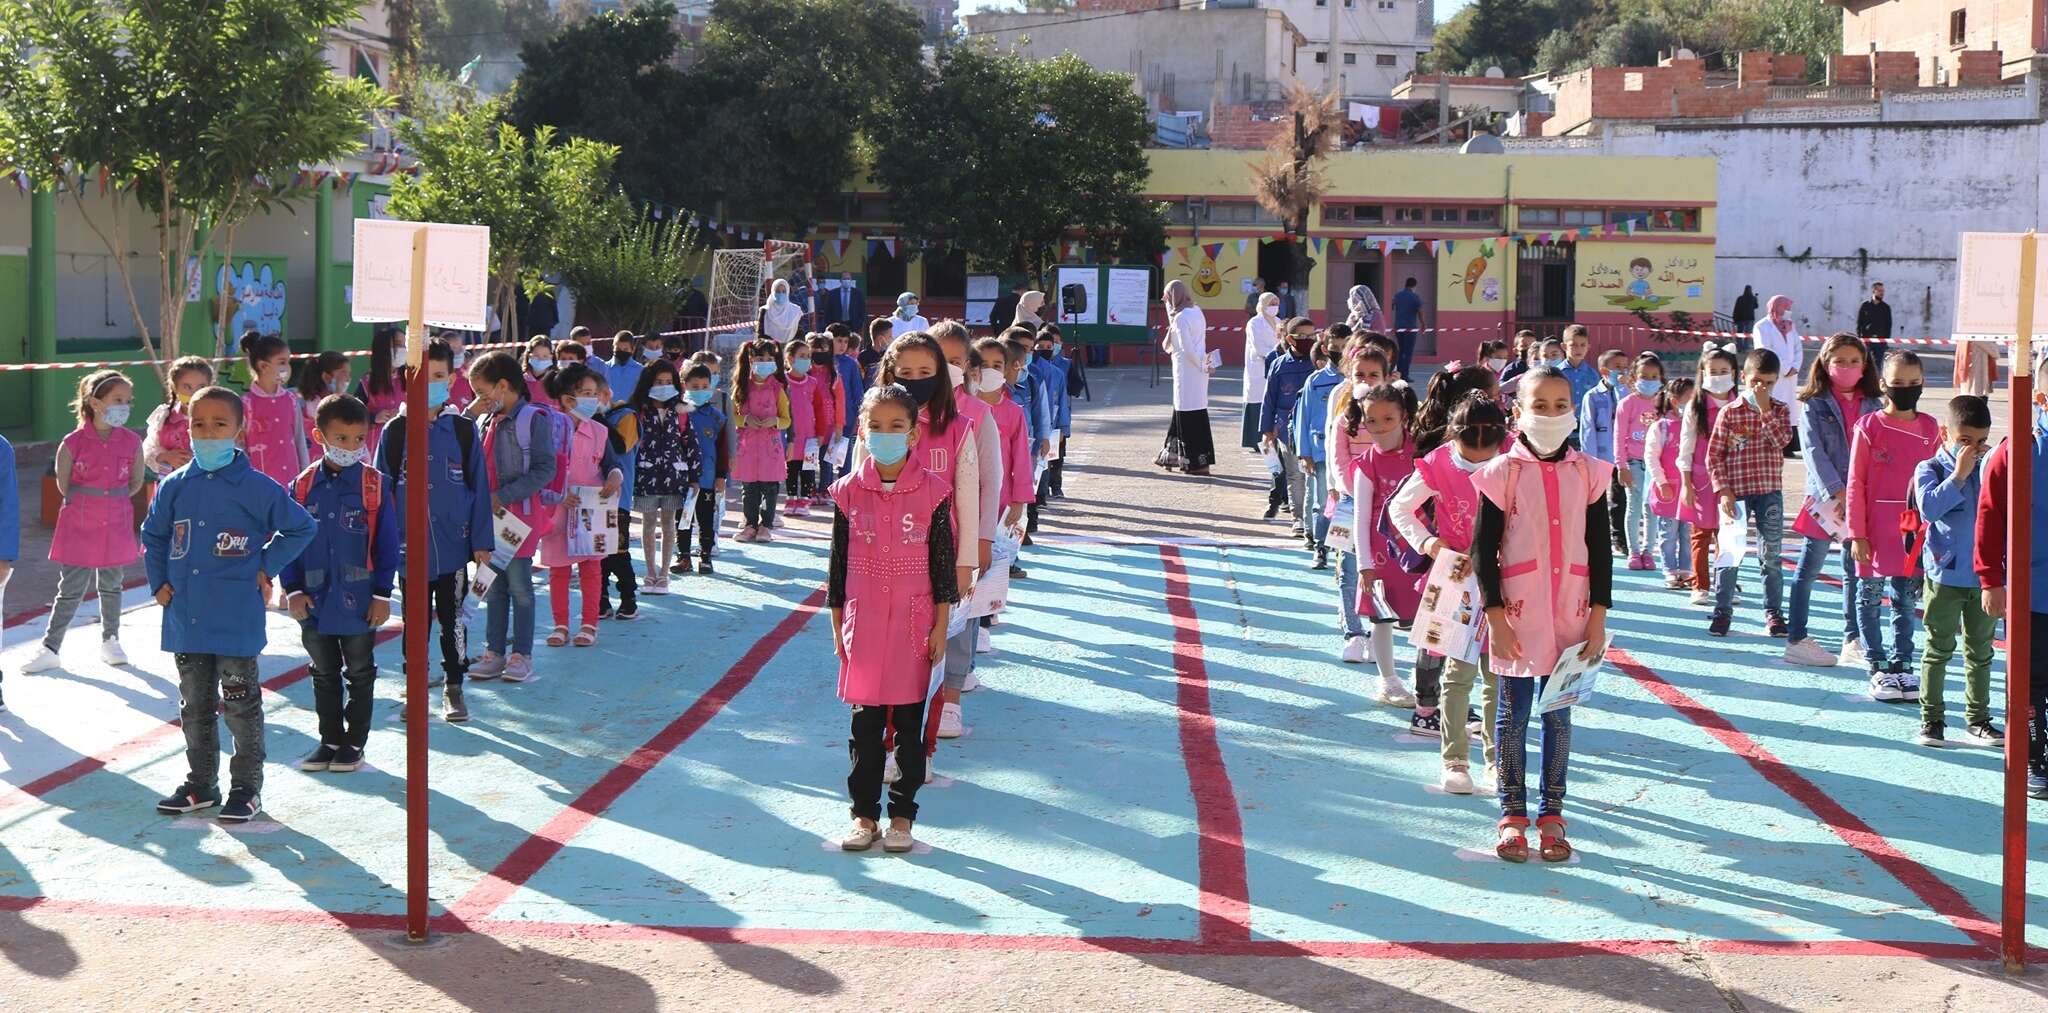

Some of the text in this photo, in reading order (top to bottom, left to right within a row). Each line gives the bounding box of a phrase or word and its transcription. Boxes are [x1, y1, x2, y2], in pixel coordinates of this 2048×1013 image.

[1598, 278, 1624, 289] الحمد
[1676, 275, 1705, 288] بسم
[930, 448, 948, 472] D
[902, 513, 913, 532] S
